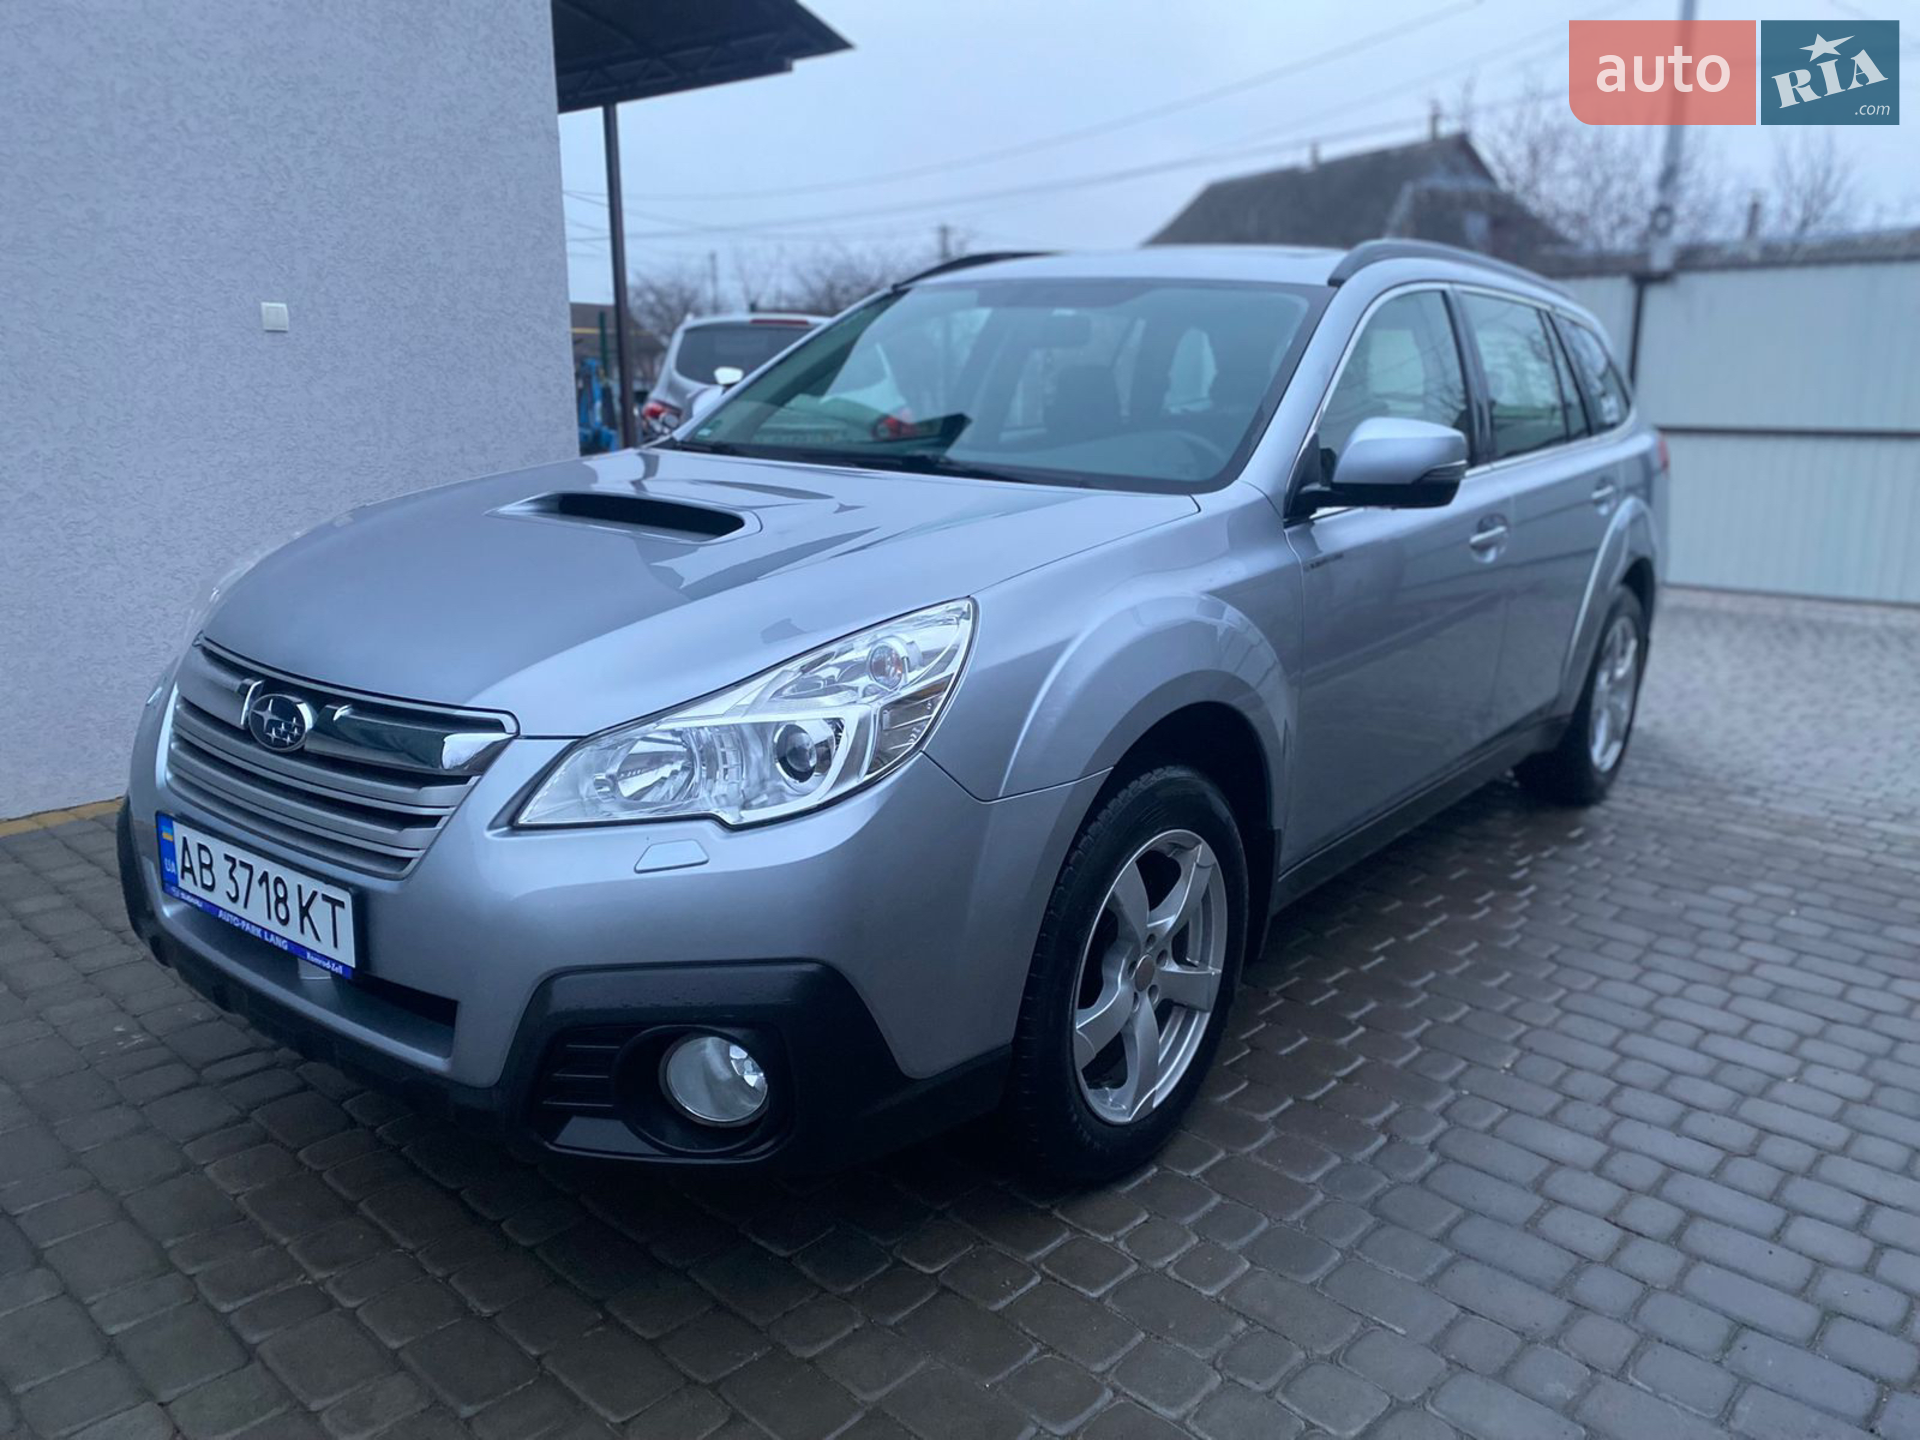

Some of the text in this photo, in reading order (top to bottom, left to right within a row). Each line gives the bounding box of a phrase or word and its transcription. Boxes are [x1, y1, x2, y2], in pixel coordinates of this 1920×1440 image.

[164, 858, 177, 875] UA
[180, 836, 346, 949] AB 3718 KT
[264, 931, 289, 951] LANG
